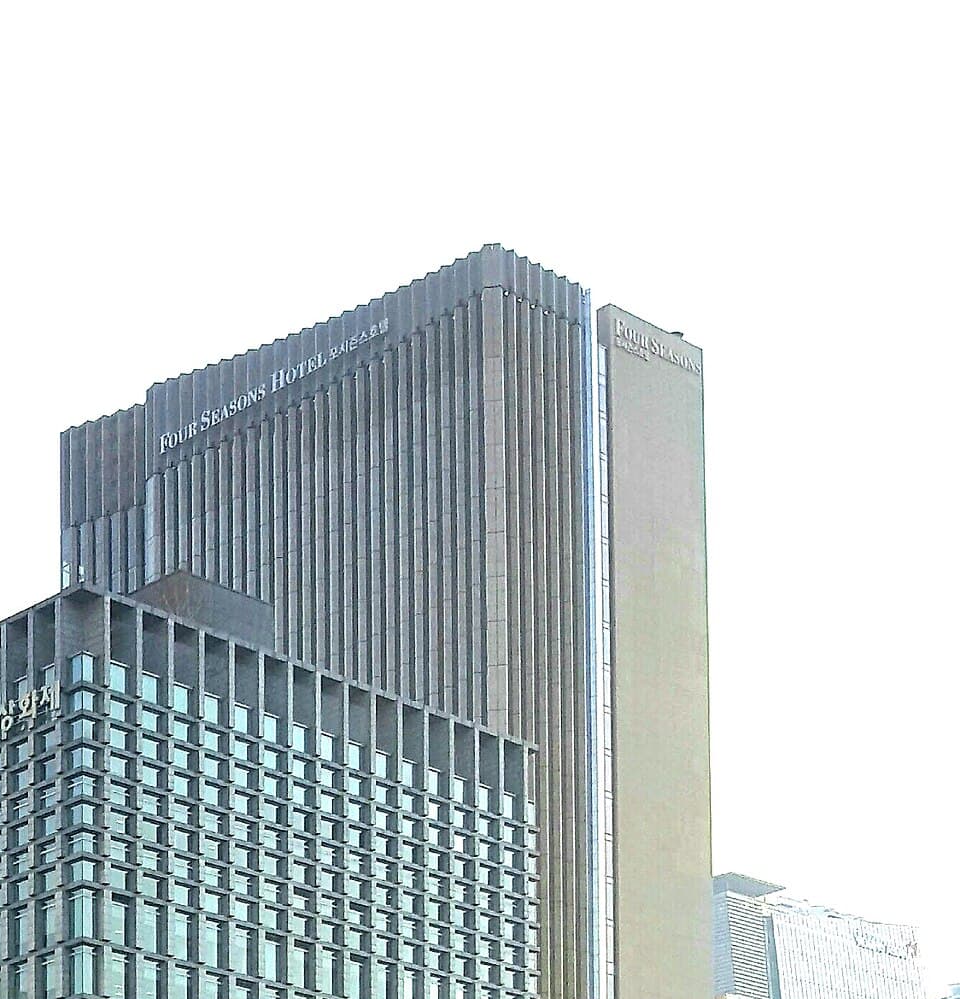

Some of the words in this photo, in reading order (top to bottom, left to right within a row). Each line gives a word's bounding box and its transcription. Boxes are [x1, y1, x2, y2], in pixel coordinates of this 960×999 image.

[159, 422, 198, 455] FOUR
[200, 383, 266, 432] SEASONS
[270, 352, 327, 394] HOTEL
